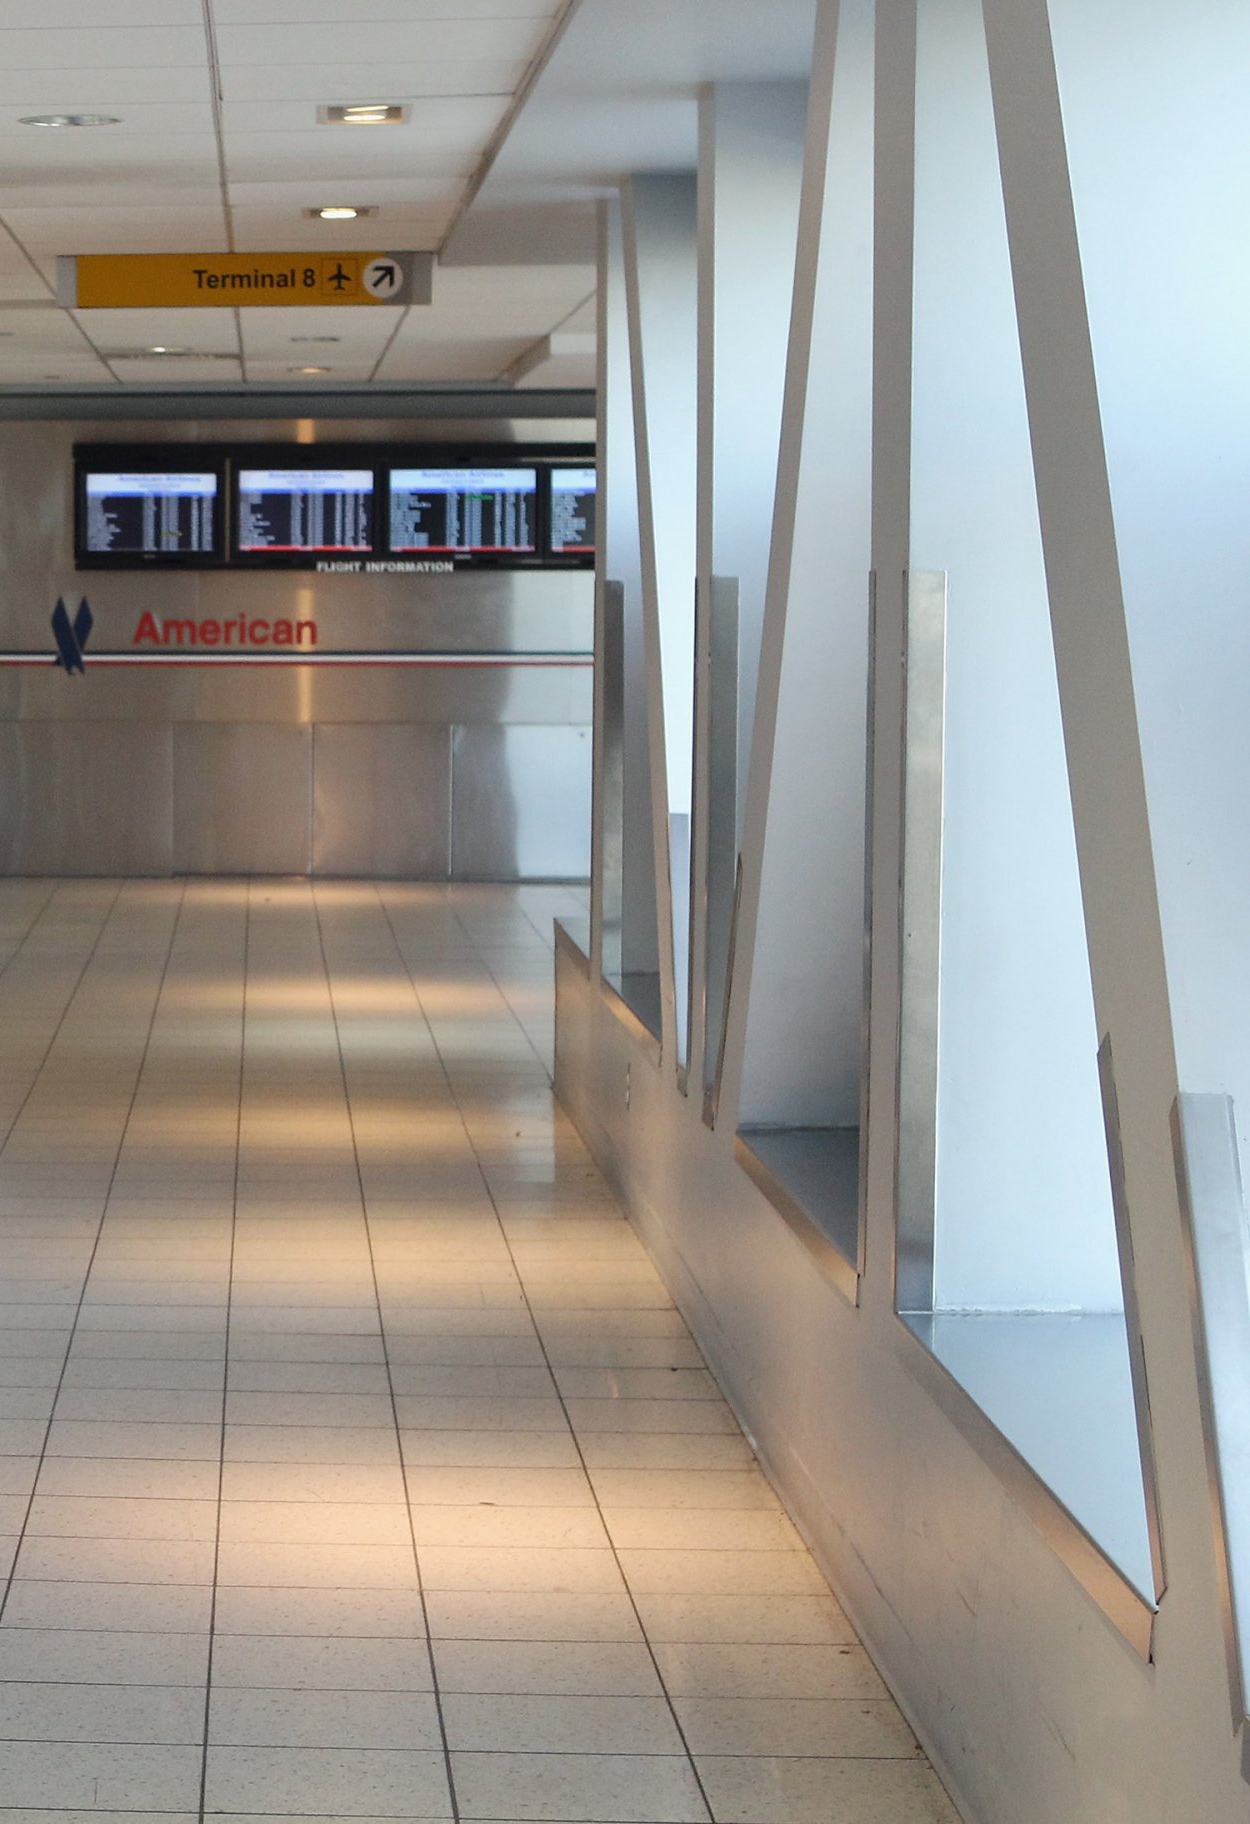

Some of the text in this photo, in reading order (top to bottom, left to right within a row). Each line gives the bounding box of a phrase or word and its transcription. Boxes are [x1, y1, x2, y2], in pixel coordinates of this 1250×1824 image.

[193, 268, 317, 289] Terminal 8
[315, 560, 454, 572] FLIGHT INFORMATION
[132, 610, 318, 646] American
